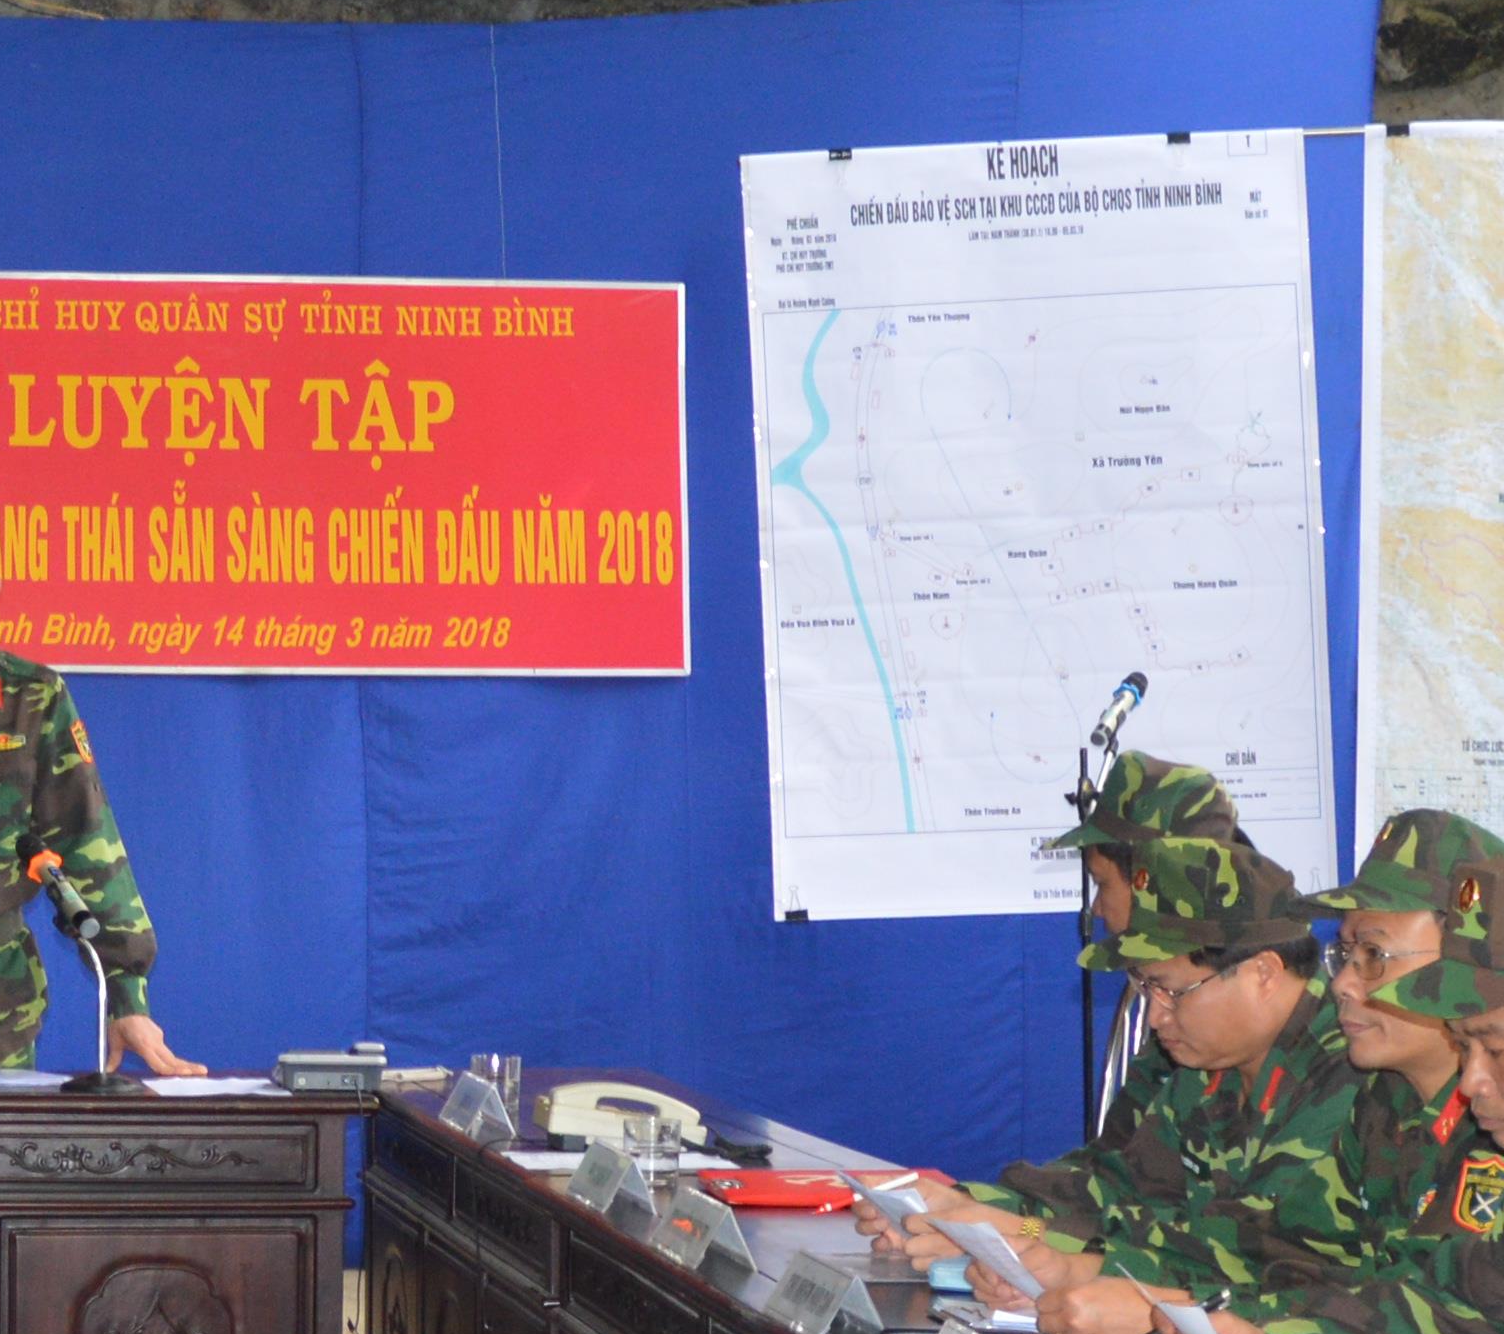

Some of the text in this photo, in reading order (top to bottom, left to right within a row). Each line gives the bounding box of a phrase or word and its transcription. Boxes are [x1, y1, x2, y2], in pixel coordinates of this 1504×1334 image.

[1010, 144, 1059, 186] HOẠCH
[1245, 134, 1251, 148] T
[850, 194, 884, 226] CHIẾN
[887, 192, 909, 223] ĐẤU
[912, 190, 934, 223] BẢO
[938, 194, 952, 227] VỆ
[954, 199, 977, 220] SCH
[980, 196, 997, 224] TẠI
[1000, 194, 1022, 217] KHU
[1026, 192, 1056, 216] CCCĐ
[1059, 182, 1081, 213] CỦA
[1085, 185, 1100, 218] BỘ
[1102, 188, 1132, 212] CHQS
[1135, 178, 1161, 209] TỈNH
[1164, 185, 1192, 208] NINH
[1195, 179, 1222, 206] BÌNH
[55, 300, 126, 332] HUY
[135, 291, 230, 335] QUÂN
[244, 296, 287, 344] SỰ
[300, 288, 383, 335] TỈNH
[396, 306, 483, 337] NINH
[493, 294, 576, 337] BÌNH
[8, 355, 456, 471] LUYỆN TẬP
[62, 491, 134, 582] THÁI
[148, 478, 215, 583] SẴN
[226, 489, 315, 584] SÀNG
[327, 484, 425, 585] CHIẾN
[435, 483, 502, 586] ĐẤU
[512, 492, 587, 585] NĂM
[597, 508, 674, 586] 2018
[42, 612, 116, 651] Bình,
[128, 613, 203, 655] ngày
[213, 615, 246, 646] 14
[254, 614, 337, 655] tháng
[346, 616, 365, 648] 3
[371, 617, 433, 649] năm
[442, 616, 512, 649] 2018
